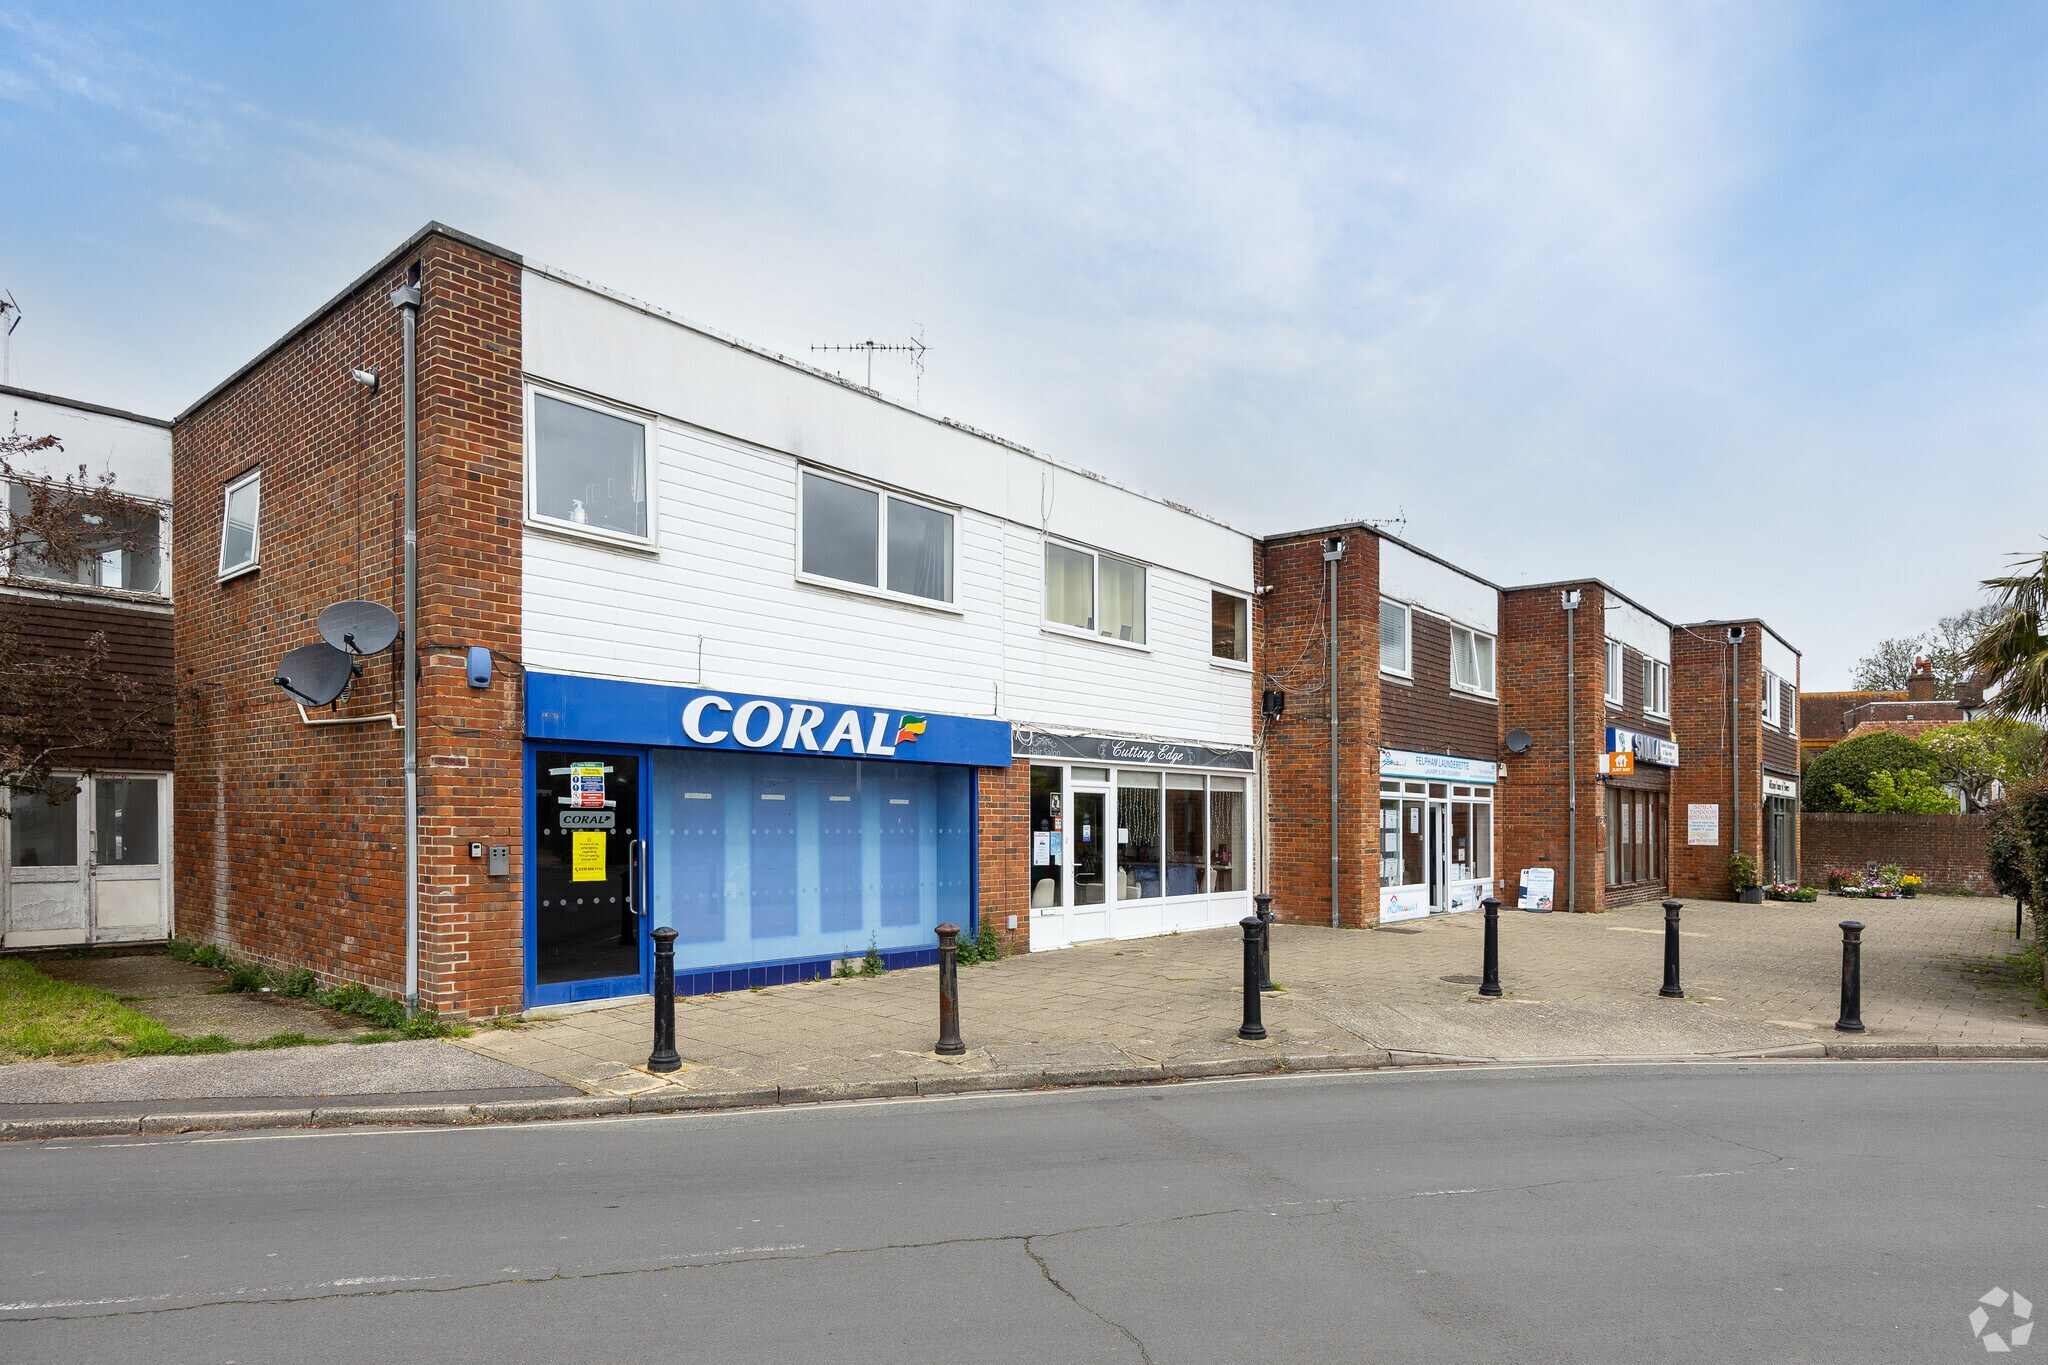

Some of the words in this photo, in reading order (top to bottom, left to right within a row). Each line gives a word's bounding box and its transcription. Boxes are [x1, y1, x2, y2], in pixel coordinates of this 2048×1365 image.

[681, 695, 896, 756] CORAL
[1029, 746, 1042, 756] Hair
[1043, 747, 1061, 757] Salon
[1111, 740, 1155, 764] Cutting
[1158, 744, 1184, 765] Edge
[1415, 756, 1438, 767] FELPHAM
[1439, 758, 1470, 771] LAUNDERETTE
[563, 815, 605, 824] CORAL
